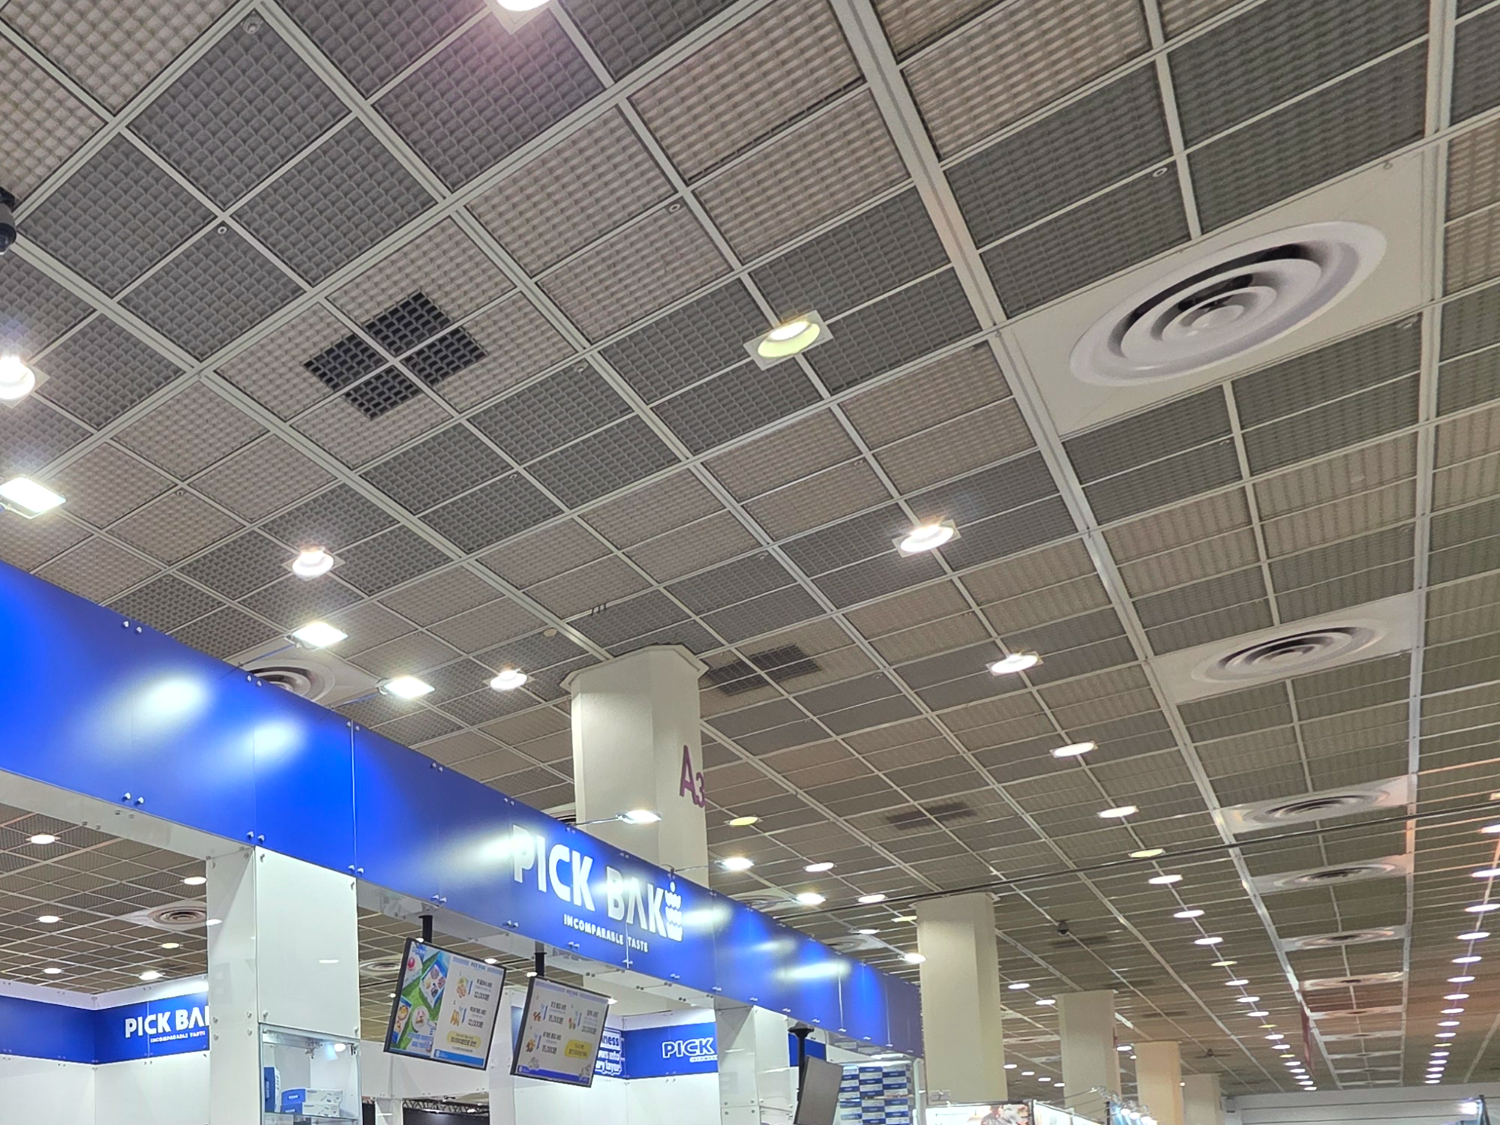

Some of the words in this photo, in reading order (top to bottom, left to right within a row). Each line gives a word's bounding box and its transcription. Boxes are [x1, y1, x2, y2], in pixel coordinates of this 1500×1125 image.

[680, 744, 706, 808] A3
[512, 824, 596, 912] PICK
[606, 866, 683, 942] BAKE
[563, 913, 624, 945] INCOMPARABLE
[627, 936, 649, 953] TASTE
[125, 1011, 171, 1038] PICK
[662, 1038, 714, 1058] PICK
